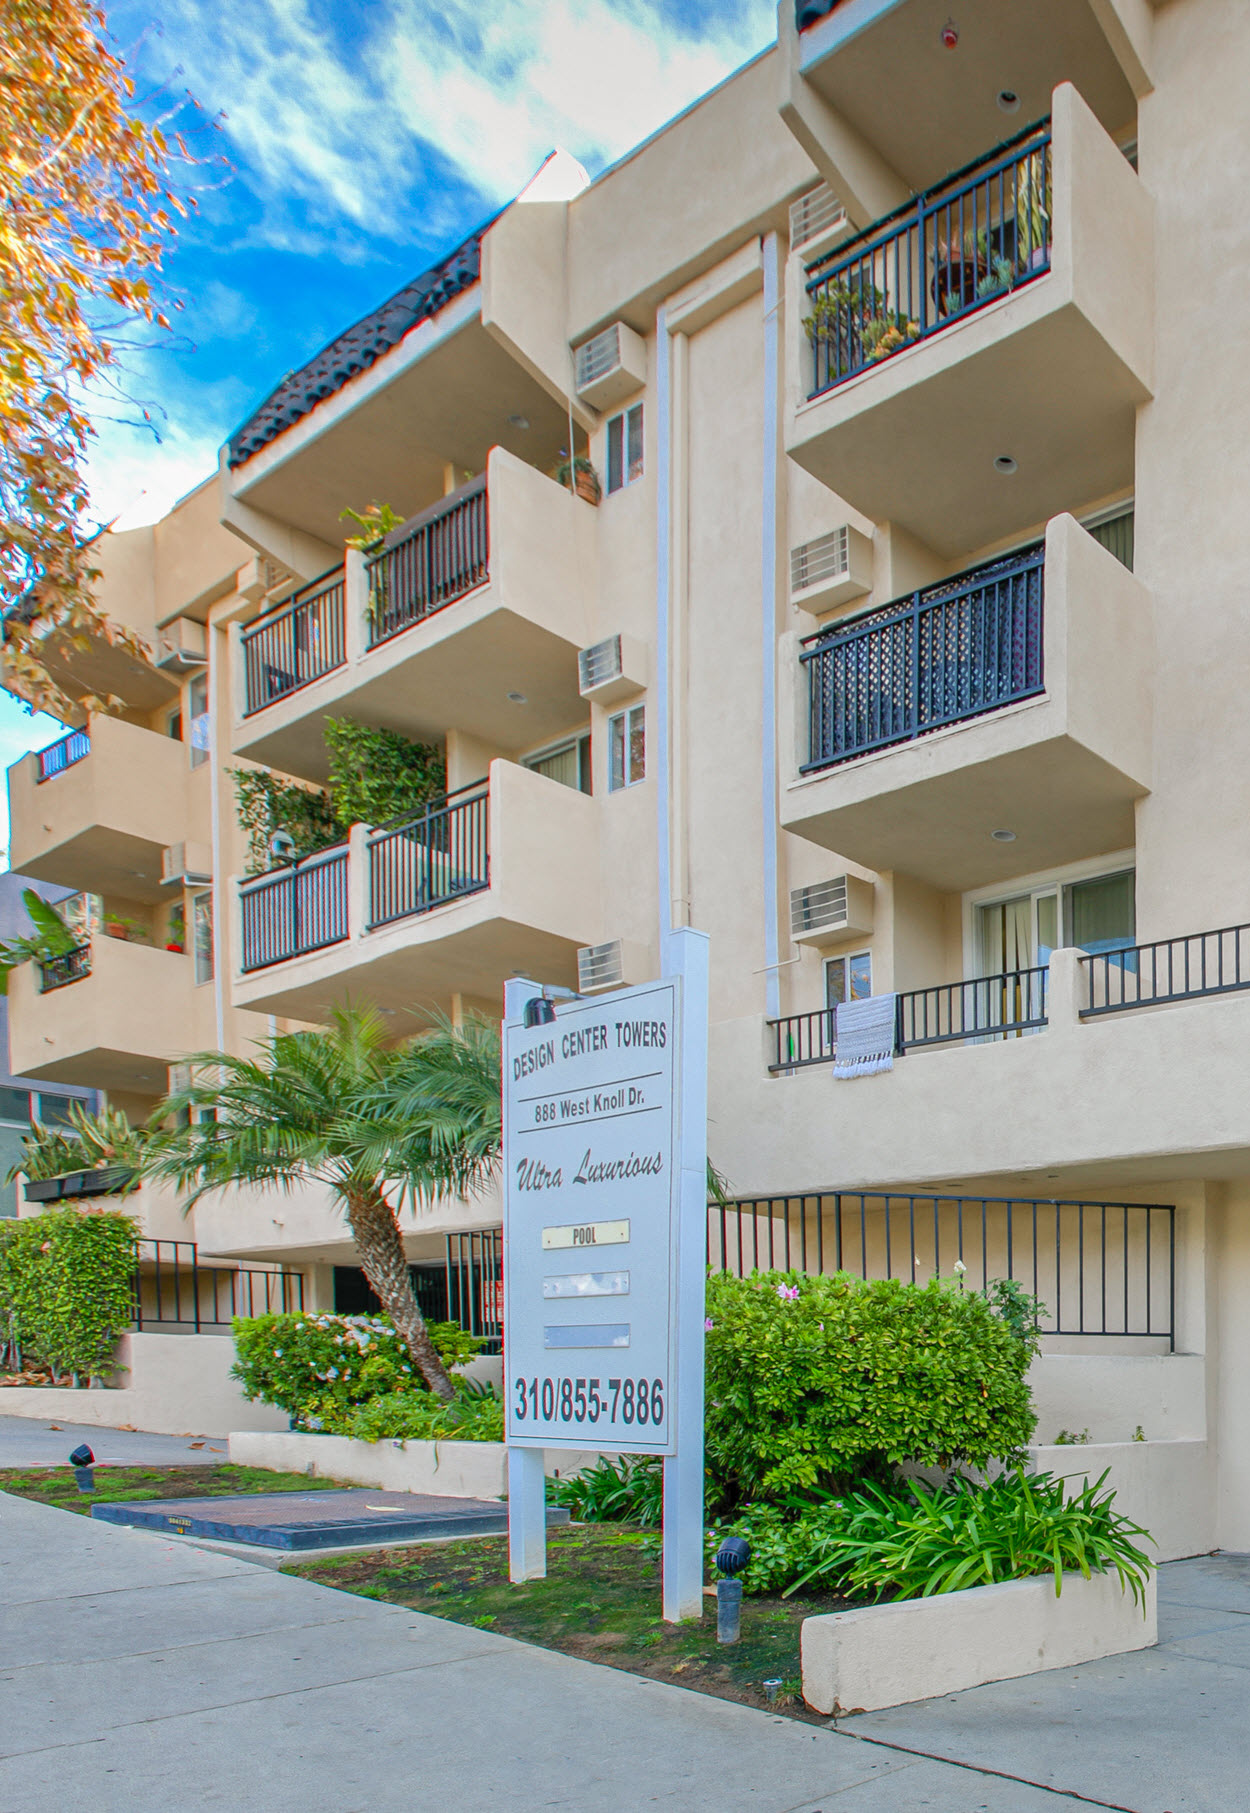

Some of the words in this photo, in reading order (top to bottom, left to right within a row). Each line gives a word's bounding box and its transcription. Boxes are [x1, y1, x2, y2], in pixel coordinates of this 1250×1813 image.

[513, 1040, 555, 1081] DESIGN
[562, 1024, 608, 1059] CENTER
[615, 1021, 667, 1048] TOWERS
[535, 1102, 556, 1123] 888
[560, 1098, 590, 1118] West
[594, 1089, 625, 1112] Knoll
[628, 1087, 645, 1106] Dr.
[516, 1157, 563, 1191] Ultra
[572, 1148, 663, 1185] Luxurious
[573, 1227, 596, 1245] POOL
[515, 1377, 664, 1426] 310/855-7886
